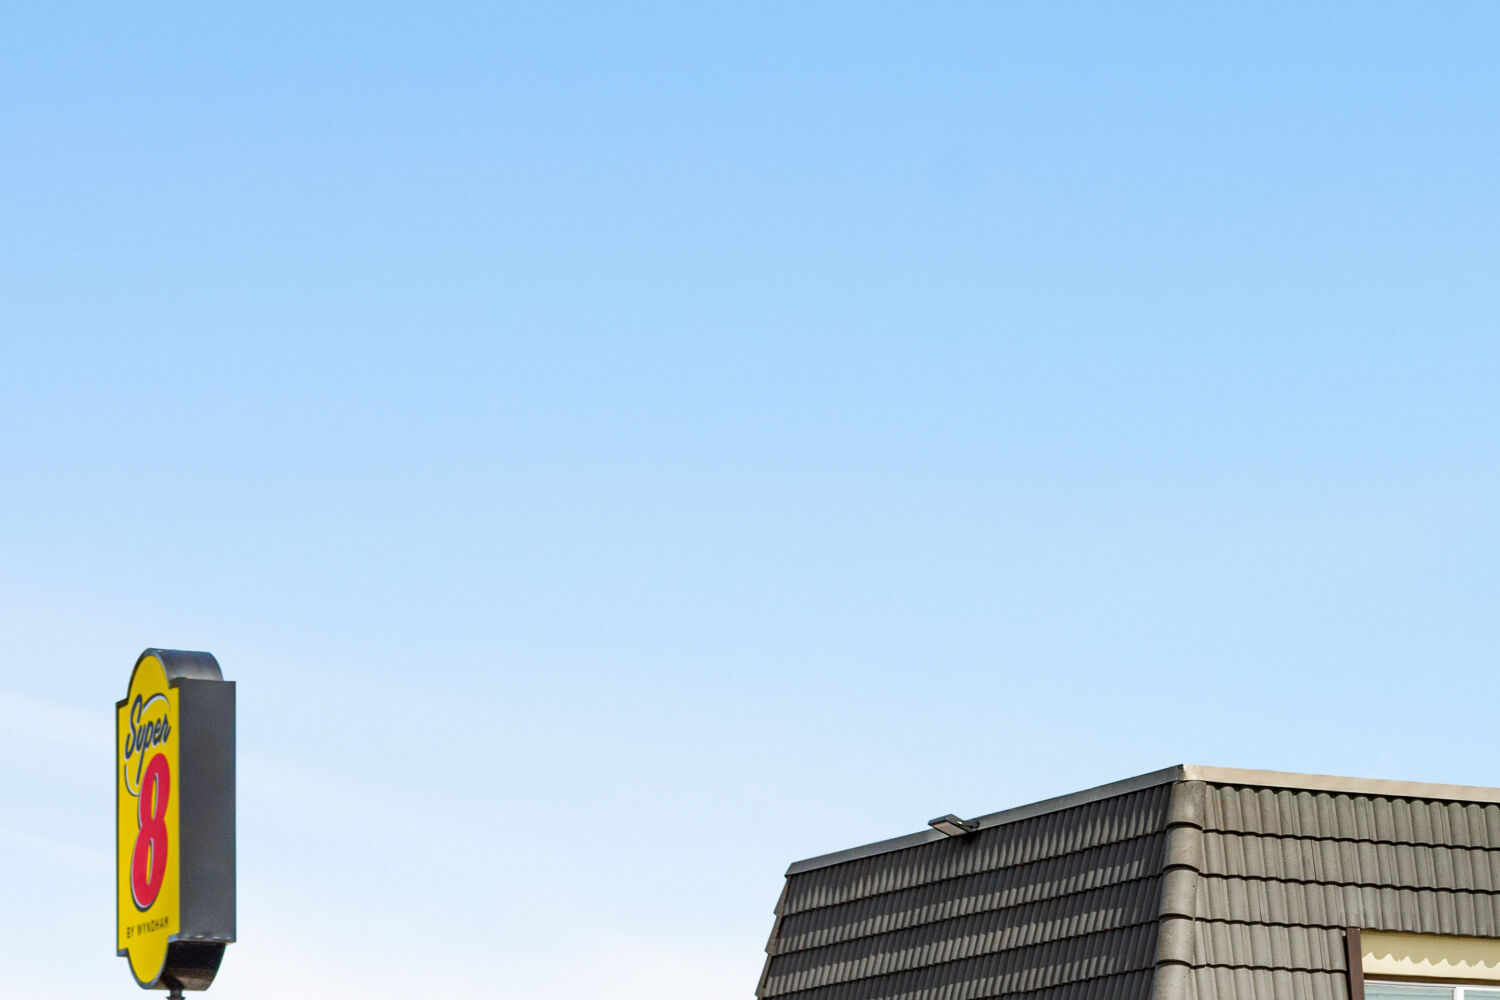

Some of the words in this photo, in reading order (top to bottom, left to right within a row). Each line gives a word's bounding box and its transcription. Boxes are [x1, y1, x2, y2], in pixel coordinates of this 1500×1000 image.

[124, 693, 171, 787] Super
[130, 752, 171, 913] 8
[137, 916, 169, 936] WYNDHAM
